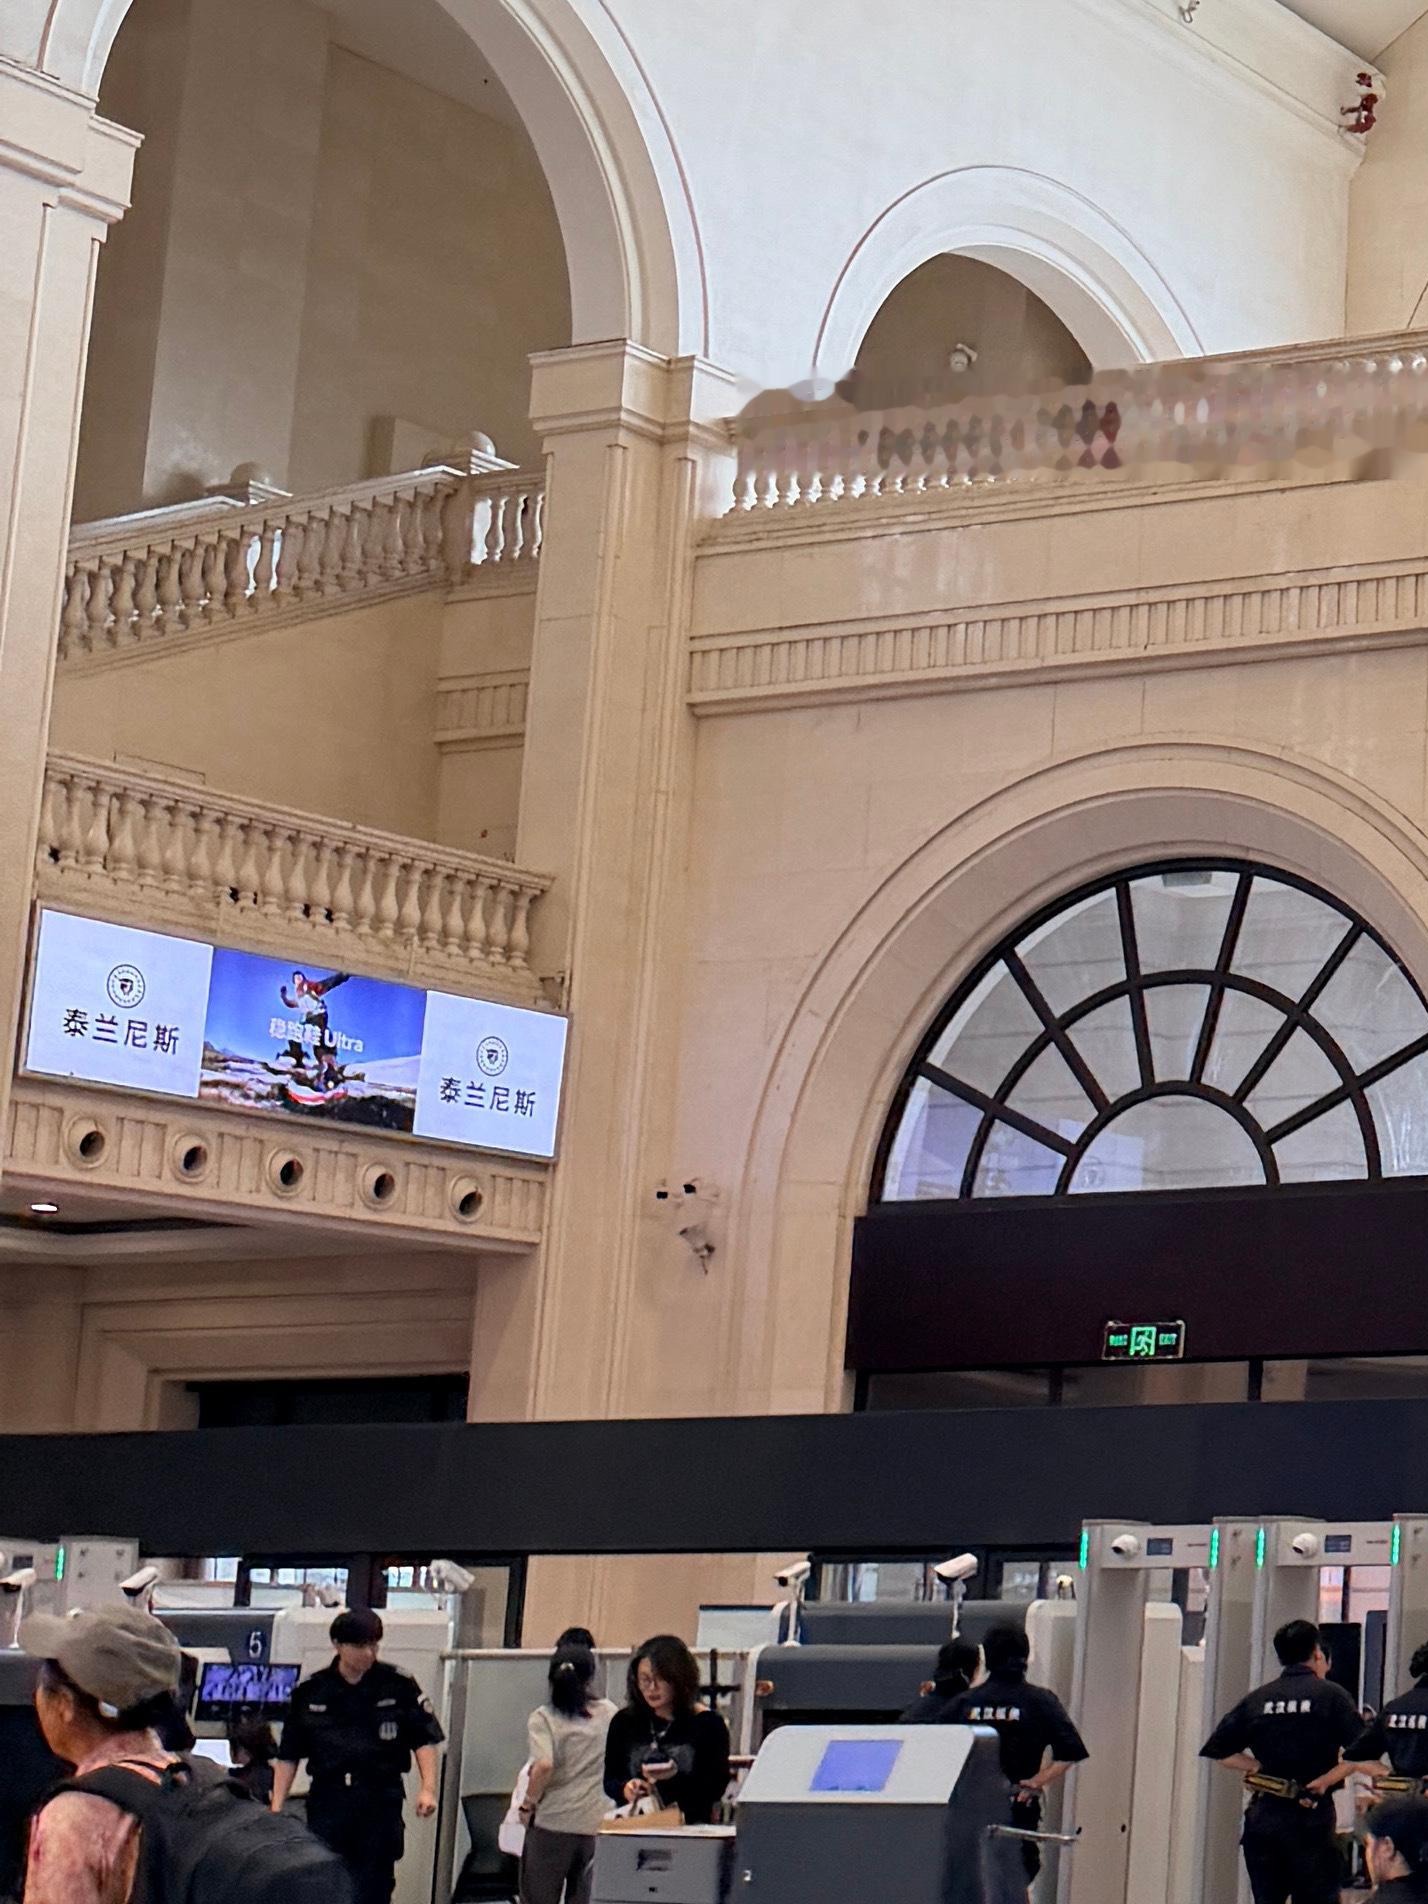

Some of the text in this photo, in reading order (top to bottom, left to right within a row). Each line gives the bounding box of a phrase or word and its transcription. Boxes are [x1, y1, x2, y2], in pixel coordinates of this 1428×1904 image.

[62, 1008, 180, 1055] 泰兰尼斯
[324, 1028, 364, 1053] Ultra
[440, 1077, 536, 1117] 泰兰尼斯
